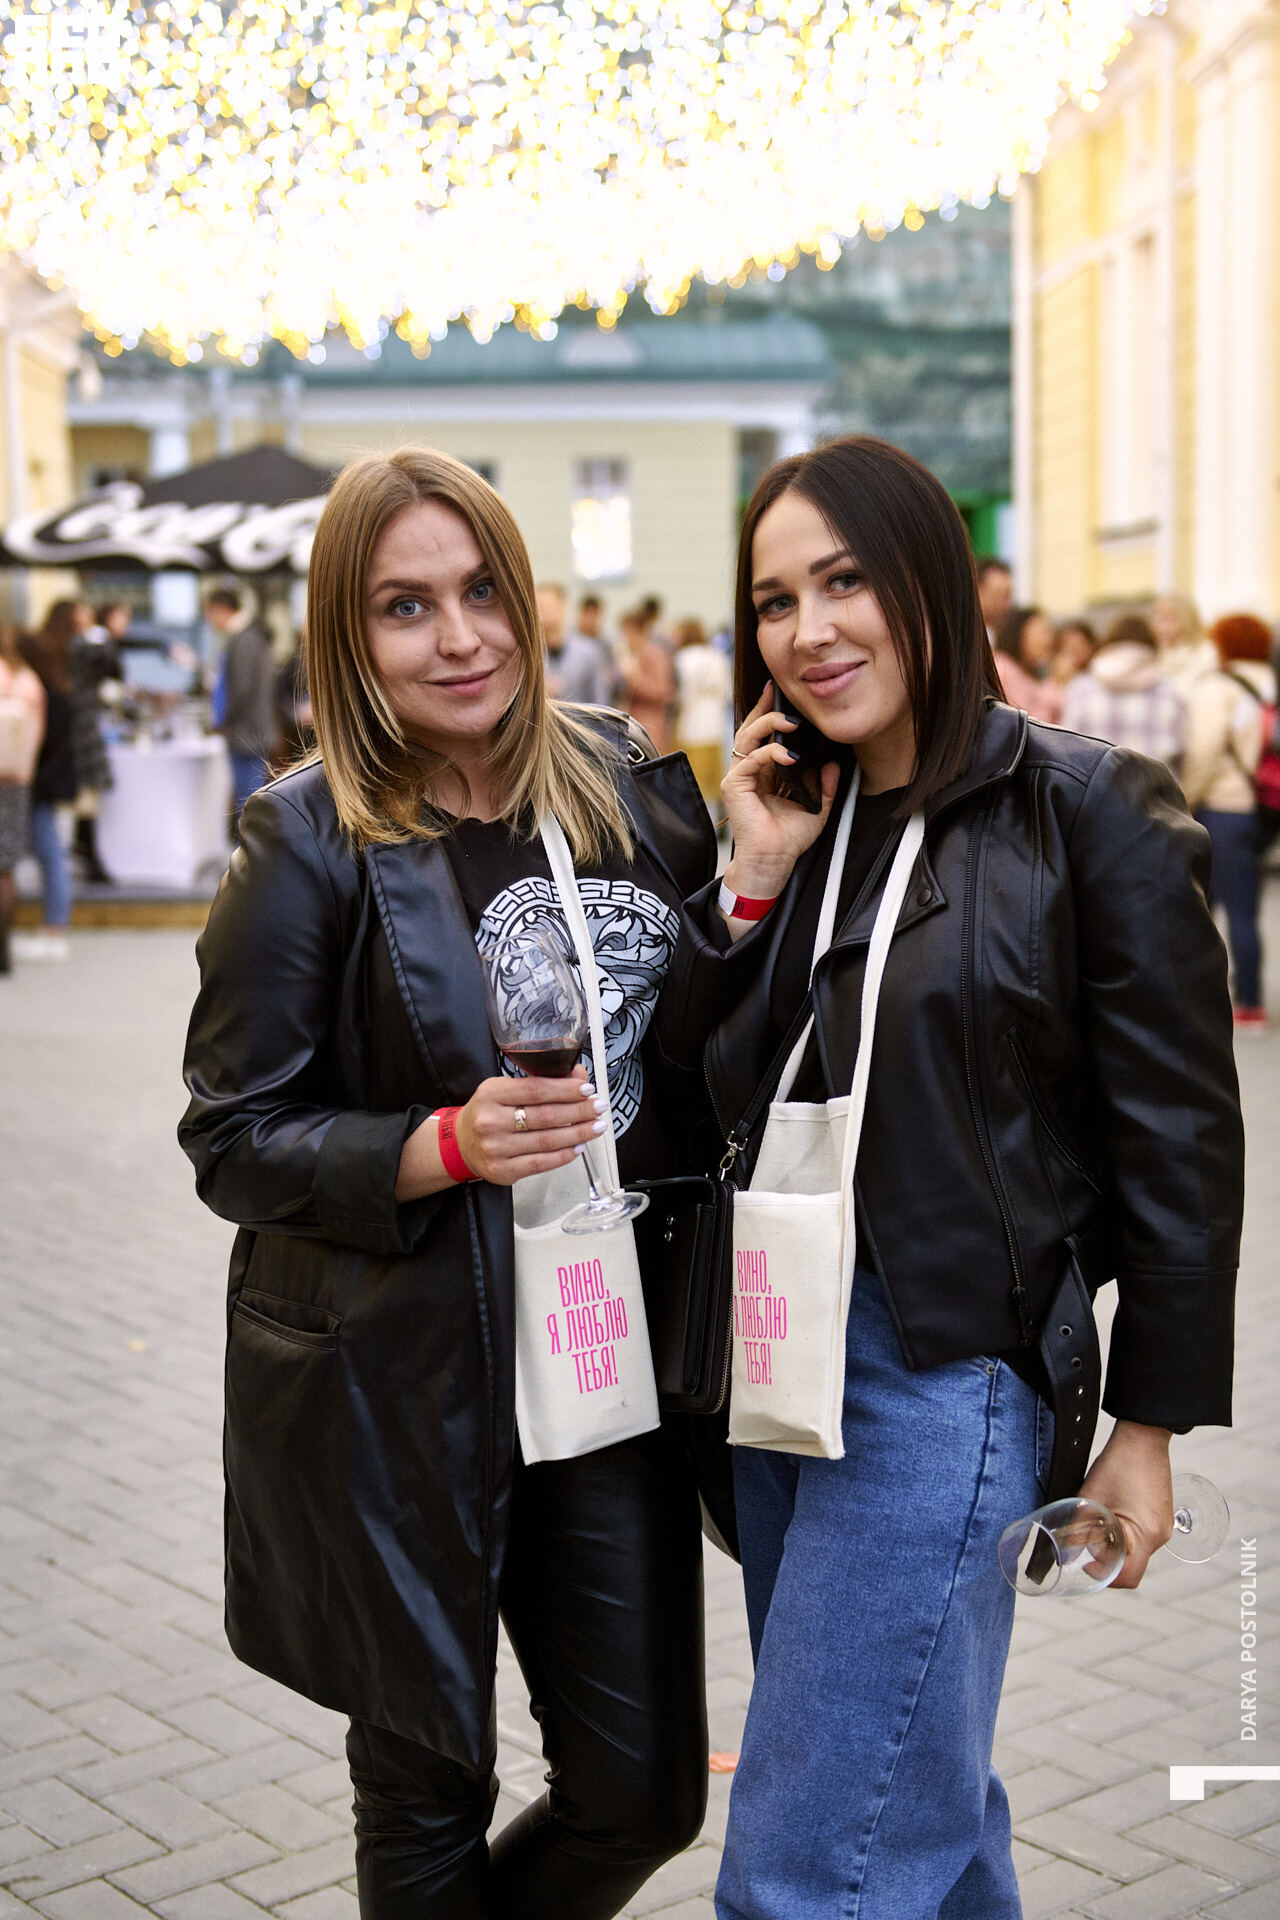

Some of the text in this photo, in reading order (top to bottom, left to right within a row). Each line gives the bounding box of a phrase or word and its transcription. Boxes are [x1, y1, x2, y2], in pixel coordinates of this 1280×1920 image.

[557, 1258, 611, 1308] ВИНО,
[736, 1249, 772, 1295] ВИНО,
[546, 1297, 629, 1356] Я ЛЮБЛЮ
[740, 1296, 788, 1341] ЛЮБЛЮ
[571, 1344, 619, 1395] ТЕБЯ!
[743, 1341, 773, 1386] ТЕБЯ!
